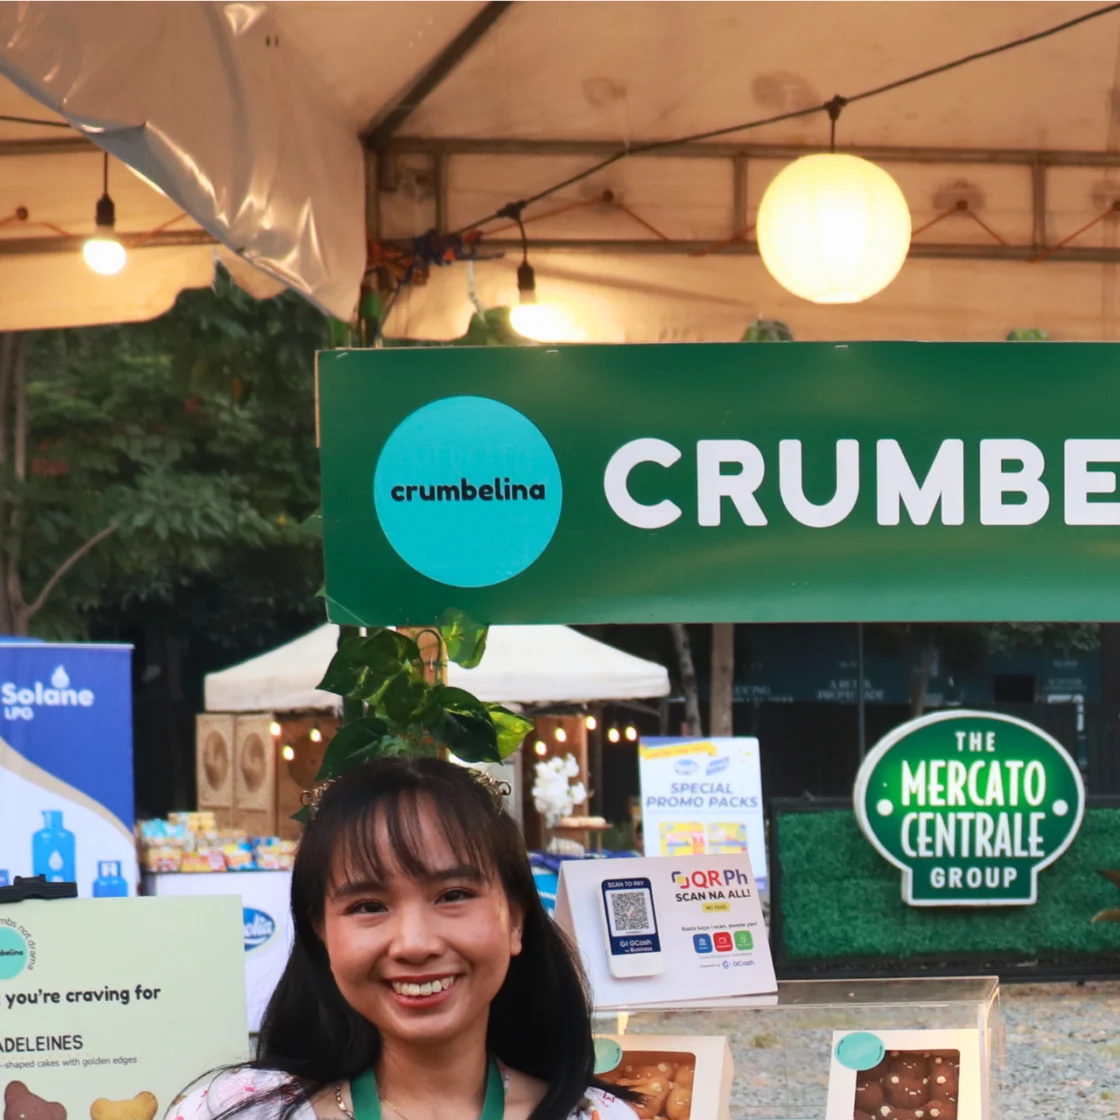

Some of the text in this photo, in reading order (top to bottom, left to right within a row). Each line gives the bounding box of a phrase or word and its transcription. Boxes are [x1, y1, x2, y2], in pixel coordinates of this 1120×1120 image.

[391, 477, 546, 502] crumbelina
[0, 682, 95, 707] Solane
[4, 707, 34, 720] LPG
[955, 731, 996, 752] THE
[670, 782, 733, 795] SPECIAL
[901, 760, 1047, 807] MERCATO
[646, 796, 759, 809] PROMO PACKS
[900, 812, 1046, 858] CENTRALE
[691, 869, 749, 888] QR Ph
[930, 867, 1018, 889] GROUP
[675, 889, 751, 902] SCAN NA ALL!
[629, 939, 652, 947] GCash
[27, 940, 36, 971] drama
[5, 984, 161, 1009] you're craving for
[37, 1059, 60, 1068] cakes
[62, 1058, 80, 1067] with
[82, 1057, 111, 1068] golden
[113, 1056, 137, 1066] edges
